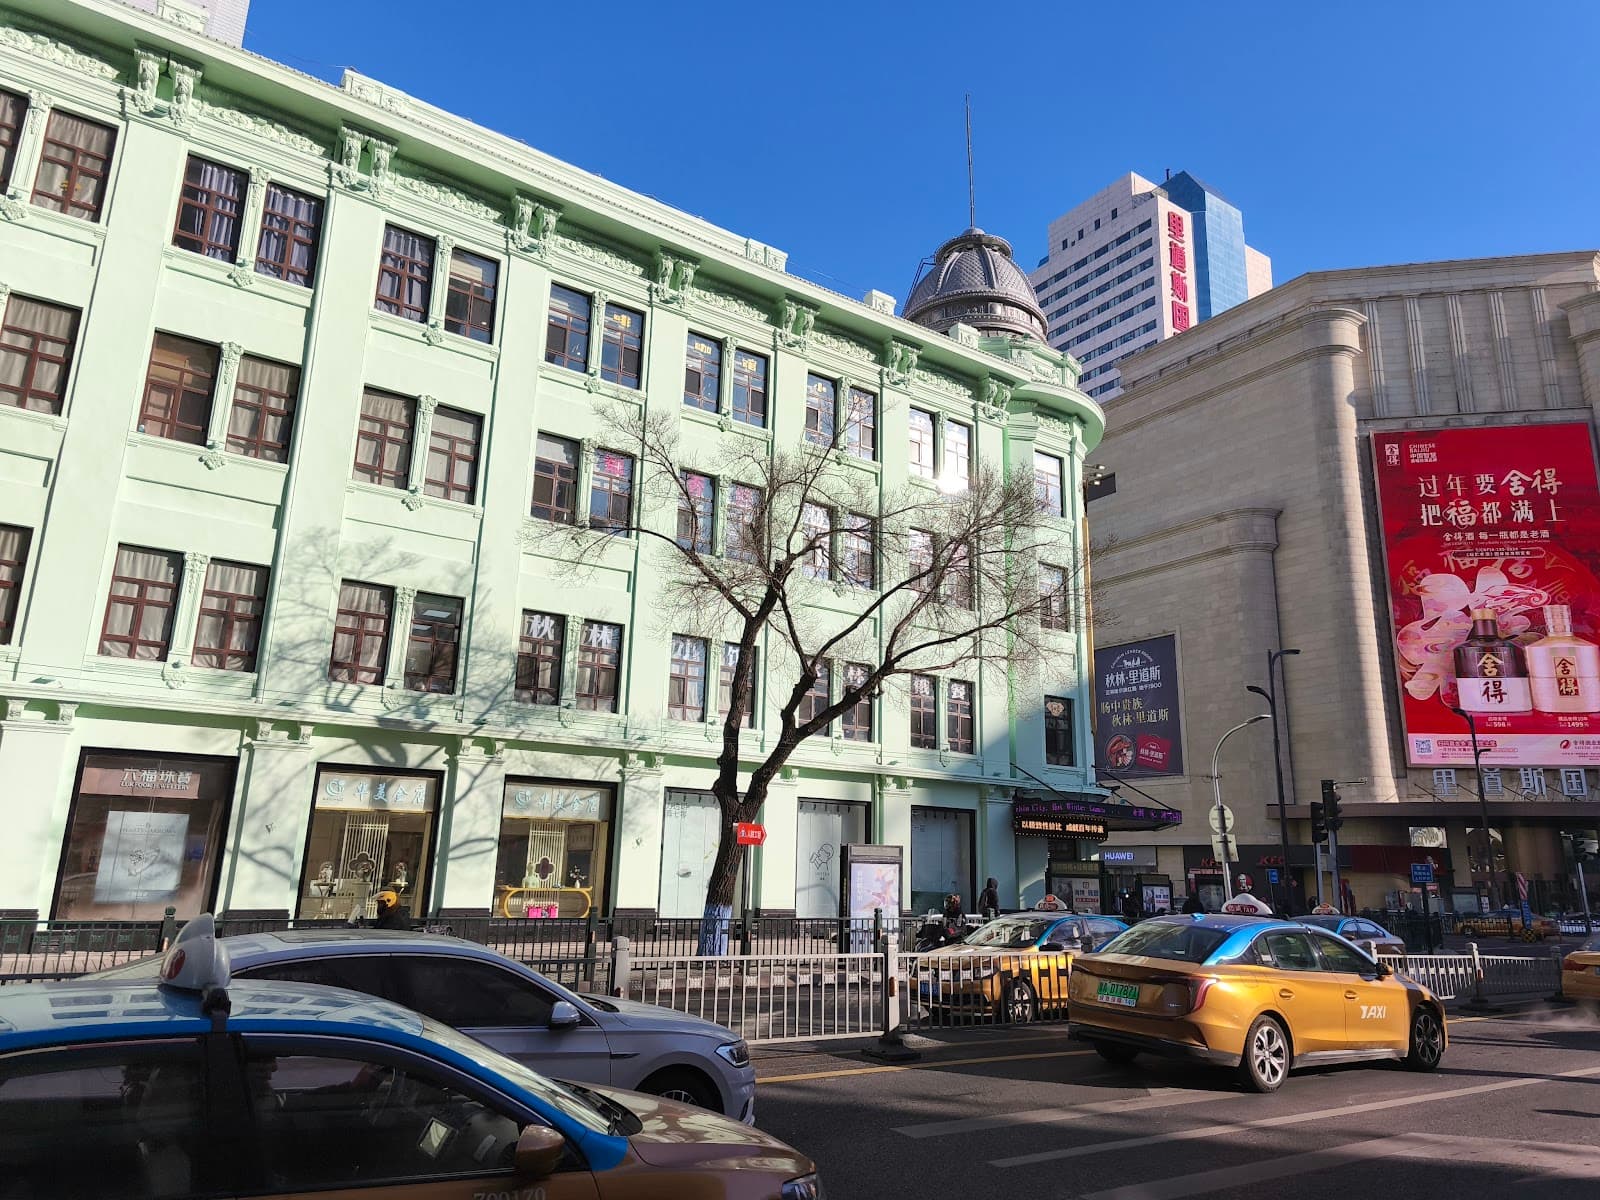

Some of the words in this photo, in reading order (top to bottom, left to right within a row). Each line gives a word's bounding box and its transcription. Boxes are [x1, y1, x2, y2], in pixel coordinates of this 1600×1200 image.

[1167, 210, 1190, 337] 里道斯国
[1418, 468, 1563, 498] 过年要舍得
[1421, 498, 1566, 527] 把福都满上
[1443, 532, 1475, 542] 舍得酒
[1478, 530, 1550, 540] 每一瓶都是老酒
[528, 614, 555, 641] 秋
[588, 623, 613, 649] 林
[1105, 665, 1161, 688] 秋林·里道斯
[1477, 652, 1508, 705] 舍得
[1555, 657, 1579, 697] 舍得
[1104, 852, 1134, 860] HUAWEI
[1200, 857, 1223, 867] KF
[1360, 1005, 1387, 1020] TAXI
